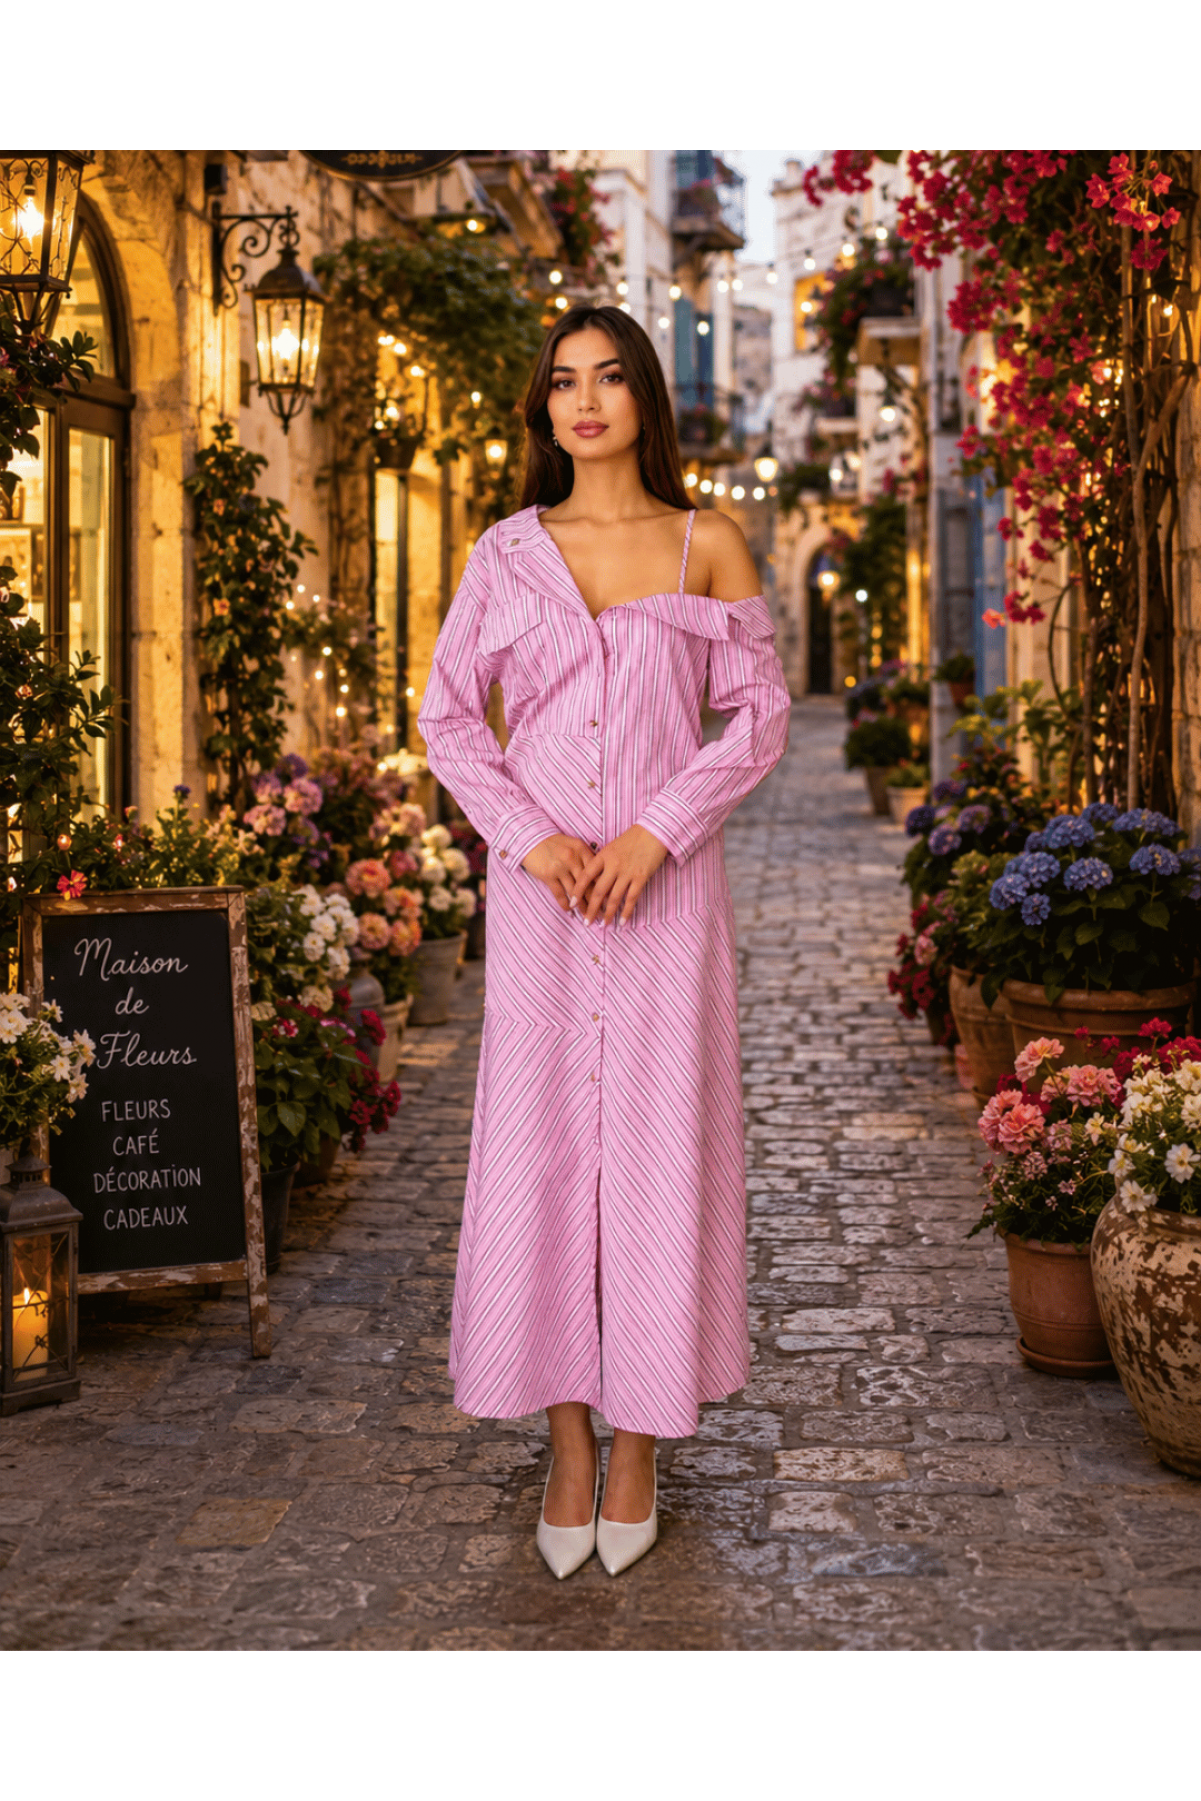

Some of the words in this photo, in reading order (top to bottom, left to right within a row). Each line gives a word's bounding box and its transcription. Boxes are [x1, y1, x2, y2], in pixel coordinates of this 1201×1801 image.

[74, 937, 189, 982] Maison
[115, 986, 150, 1015] de
[97, 1030, 197, 1069] Fleurs
[101, 1098, 171, 1122] FLEURS
[113, 1128, 160, 1156] CAFÉ
[104, 1205, 188, 1230] CADEAUX
